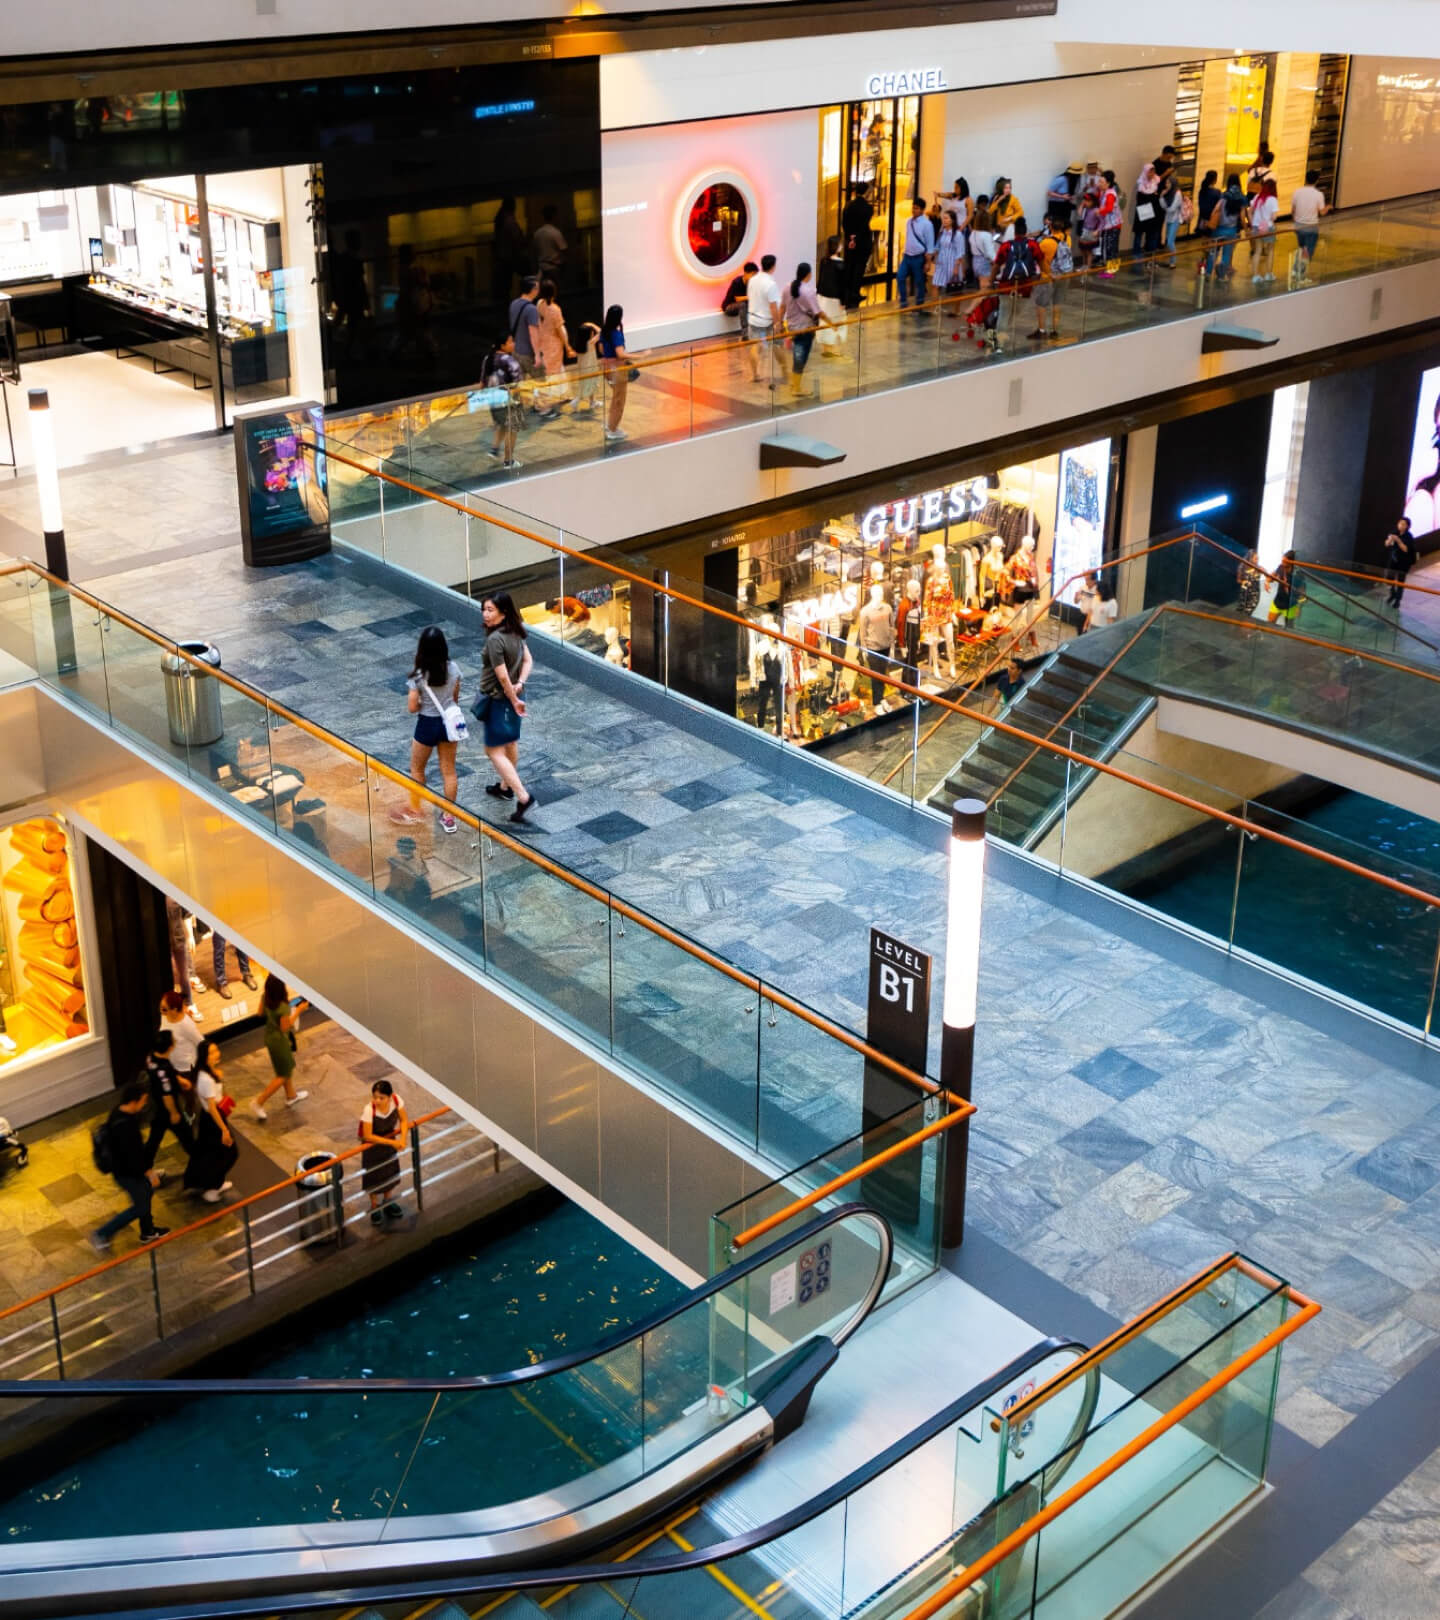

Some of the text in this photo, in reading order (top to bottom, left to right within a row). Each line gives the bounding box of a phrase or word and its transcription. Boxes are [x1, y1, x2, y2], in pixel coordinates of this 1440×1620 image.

[868, 69, 948, 96] CHANEL
[861, 476, 989, 543] GUESS
[876, 936, 922, 972] LEVEL
[880, 963, 915, 1014] B1
